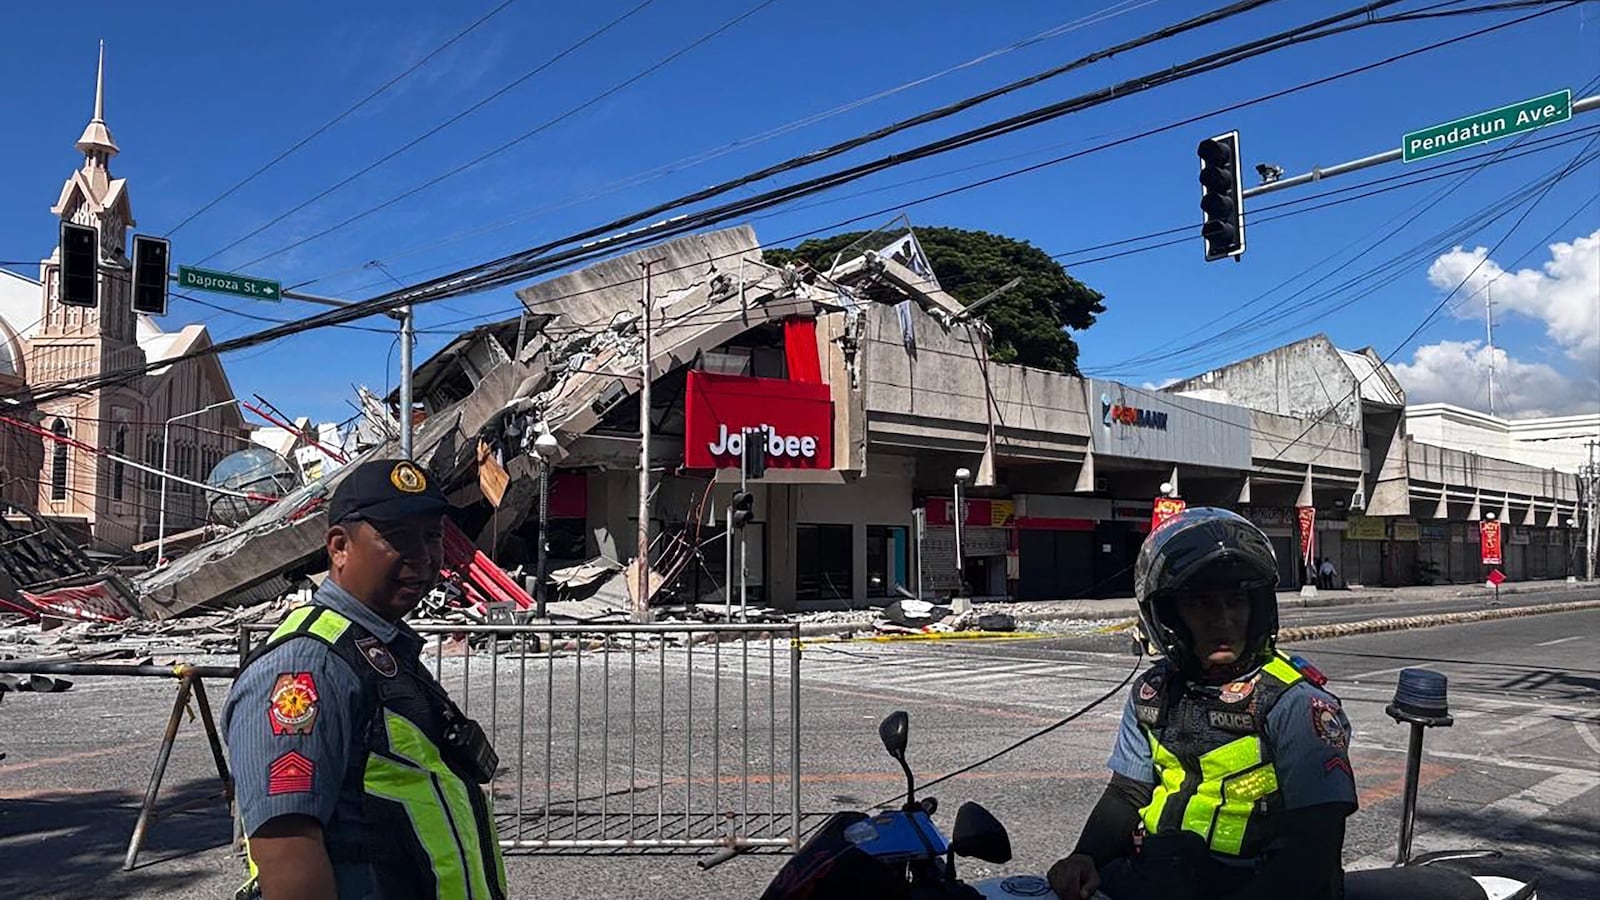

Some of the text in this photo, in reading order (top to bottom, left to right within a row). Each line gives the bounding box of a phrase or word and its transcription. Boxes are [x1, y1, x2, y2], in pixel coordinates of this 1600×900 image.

[1411, 103, 1562, 154] Pendatun Ave.
[187, 272, 260, 294] Daproza St.
[1210, 711, 1252, 727] POLICE
